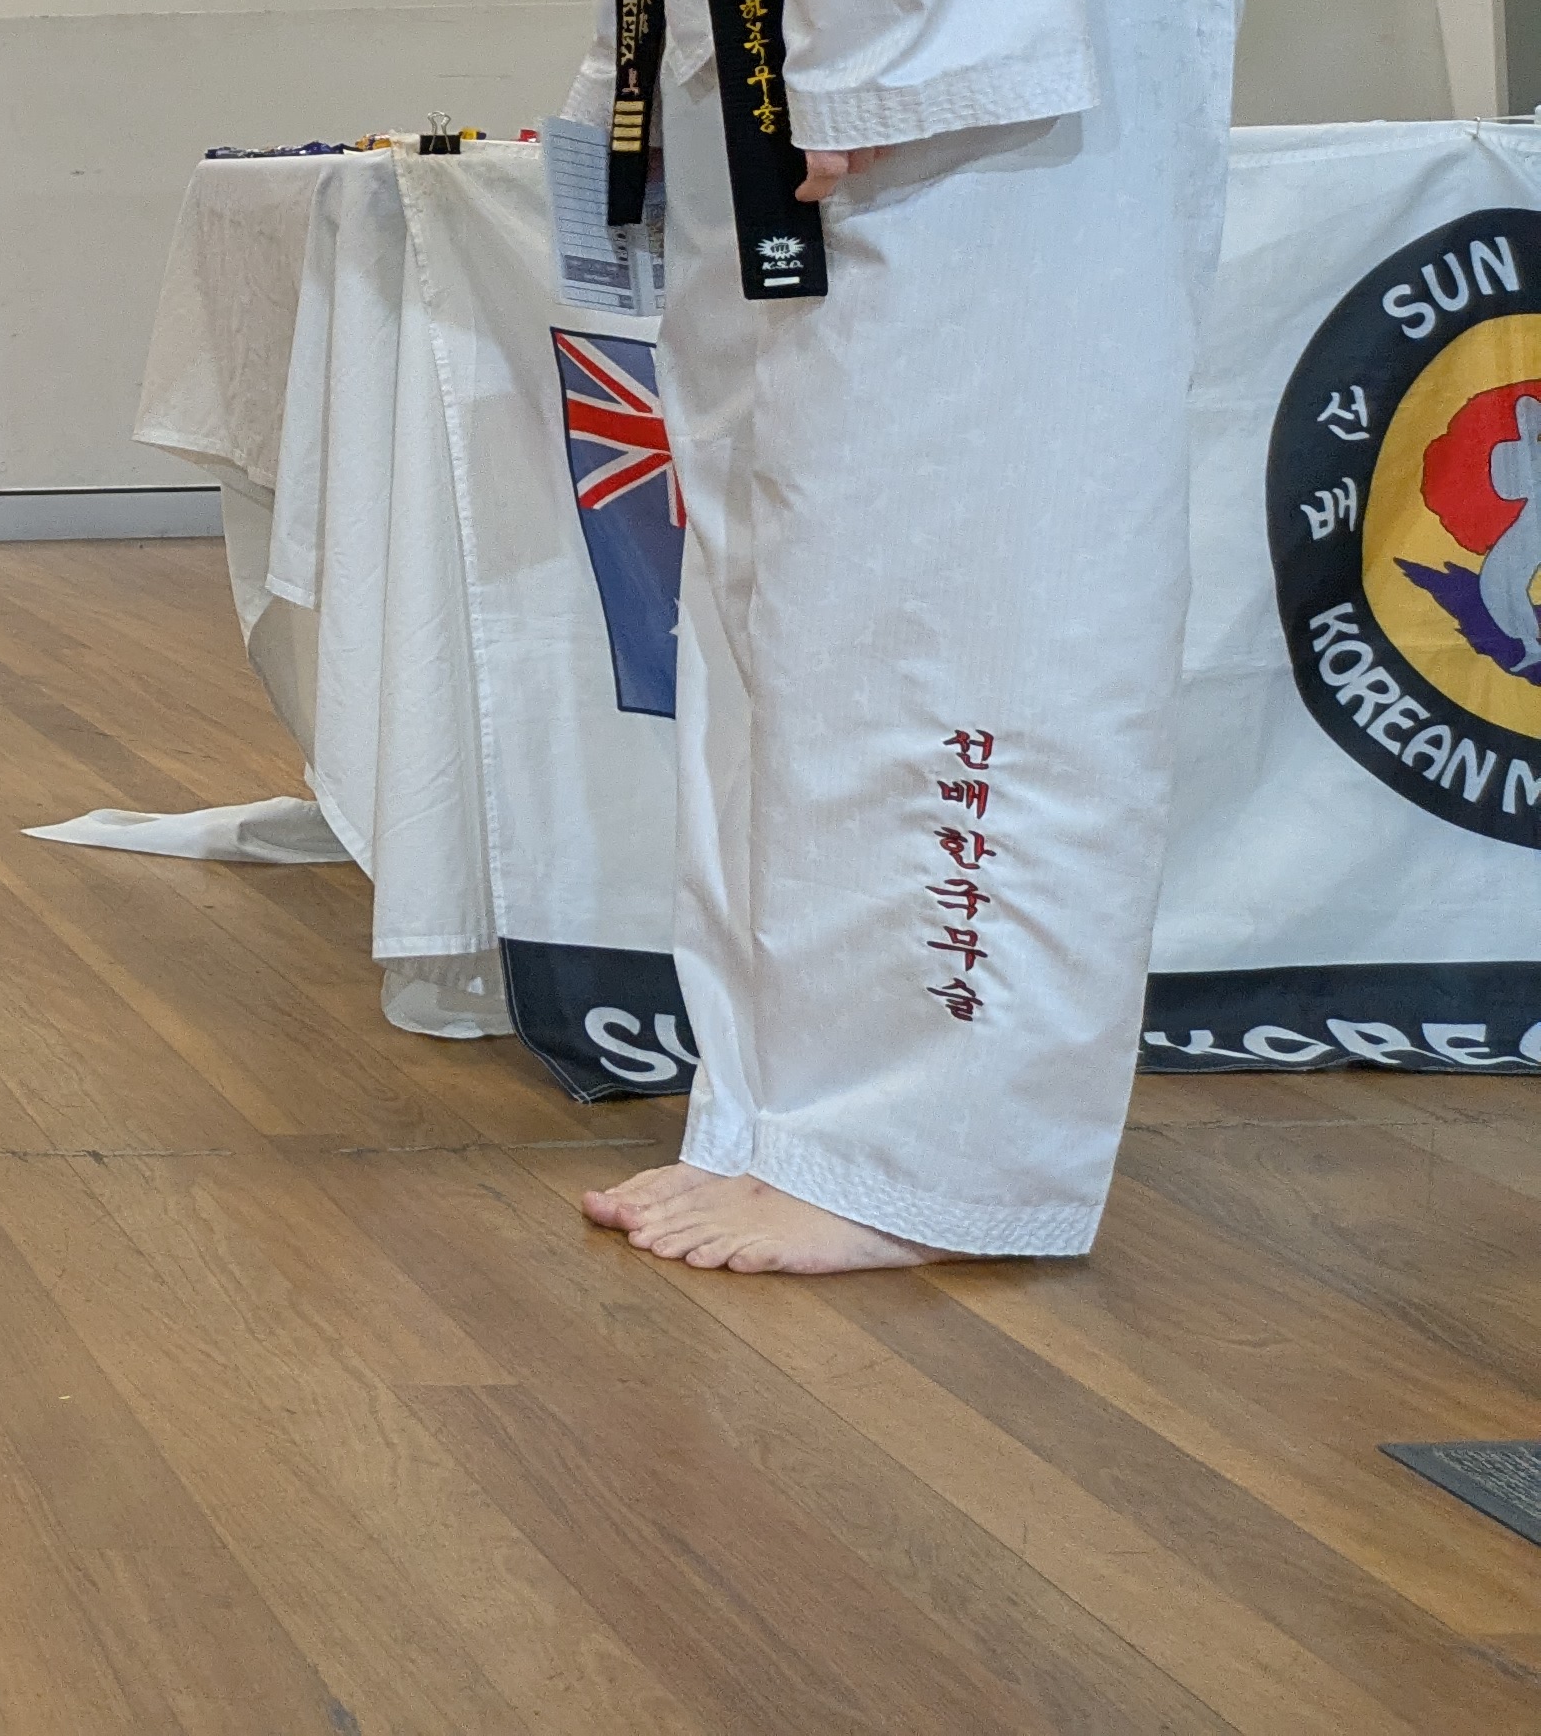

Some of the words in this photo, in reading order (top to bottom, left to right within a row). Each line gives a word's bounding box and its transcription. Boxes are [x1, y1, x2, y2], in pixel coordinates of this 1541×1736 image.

[1382, 236, 1520, 340] SUN
[1309, 602, 1498, 804] KOREAN
[925, 728, 997, 1022] 선배한국무술
